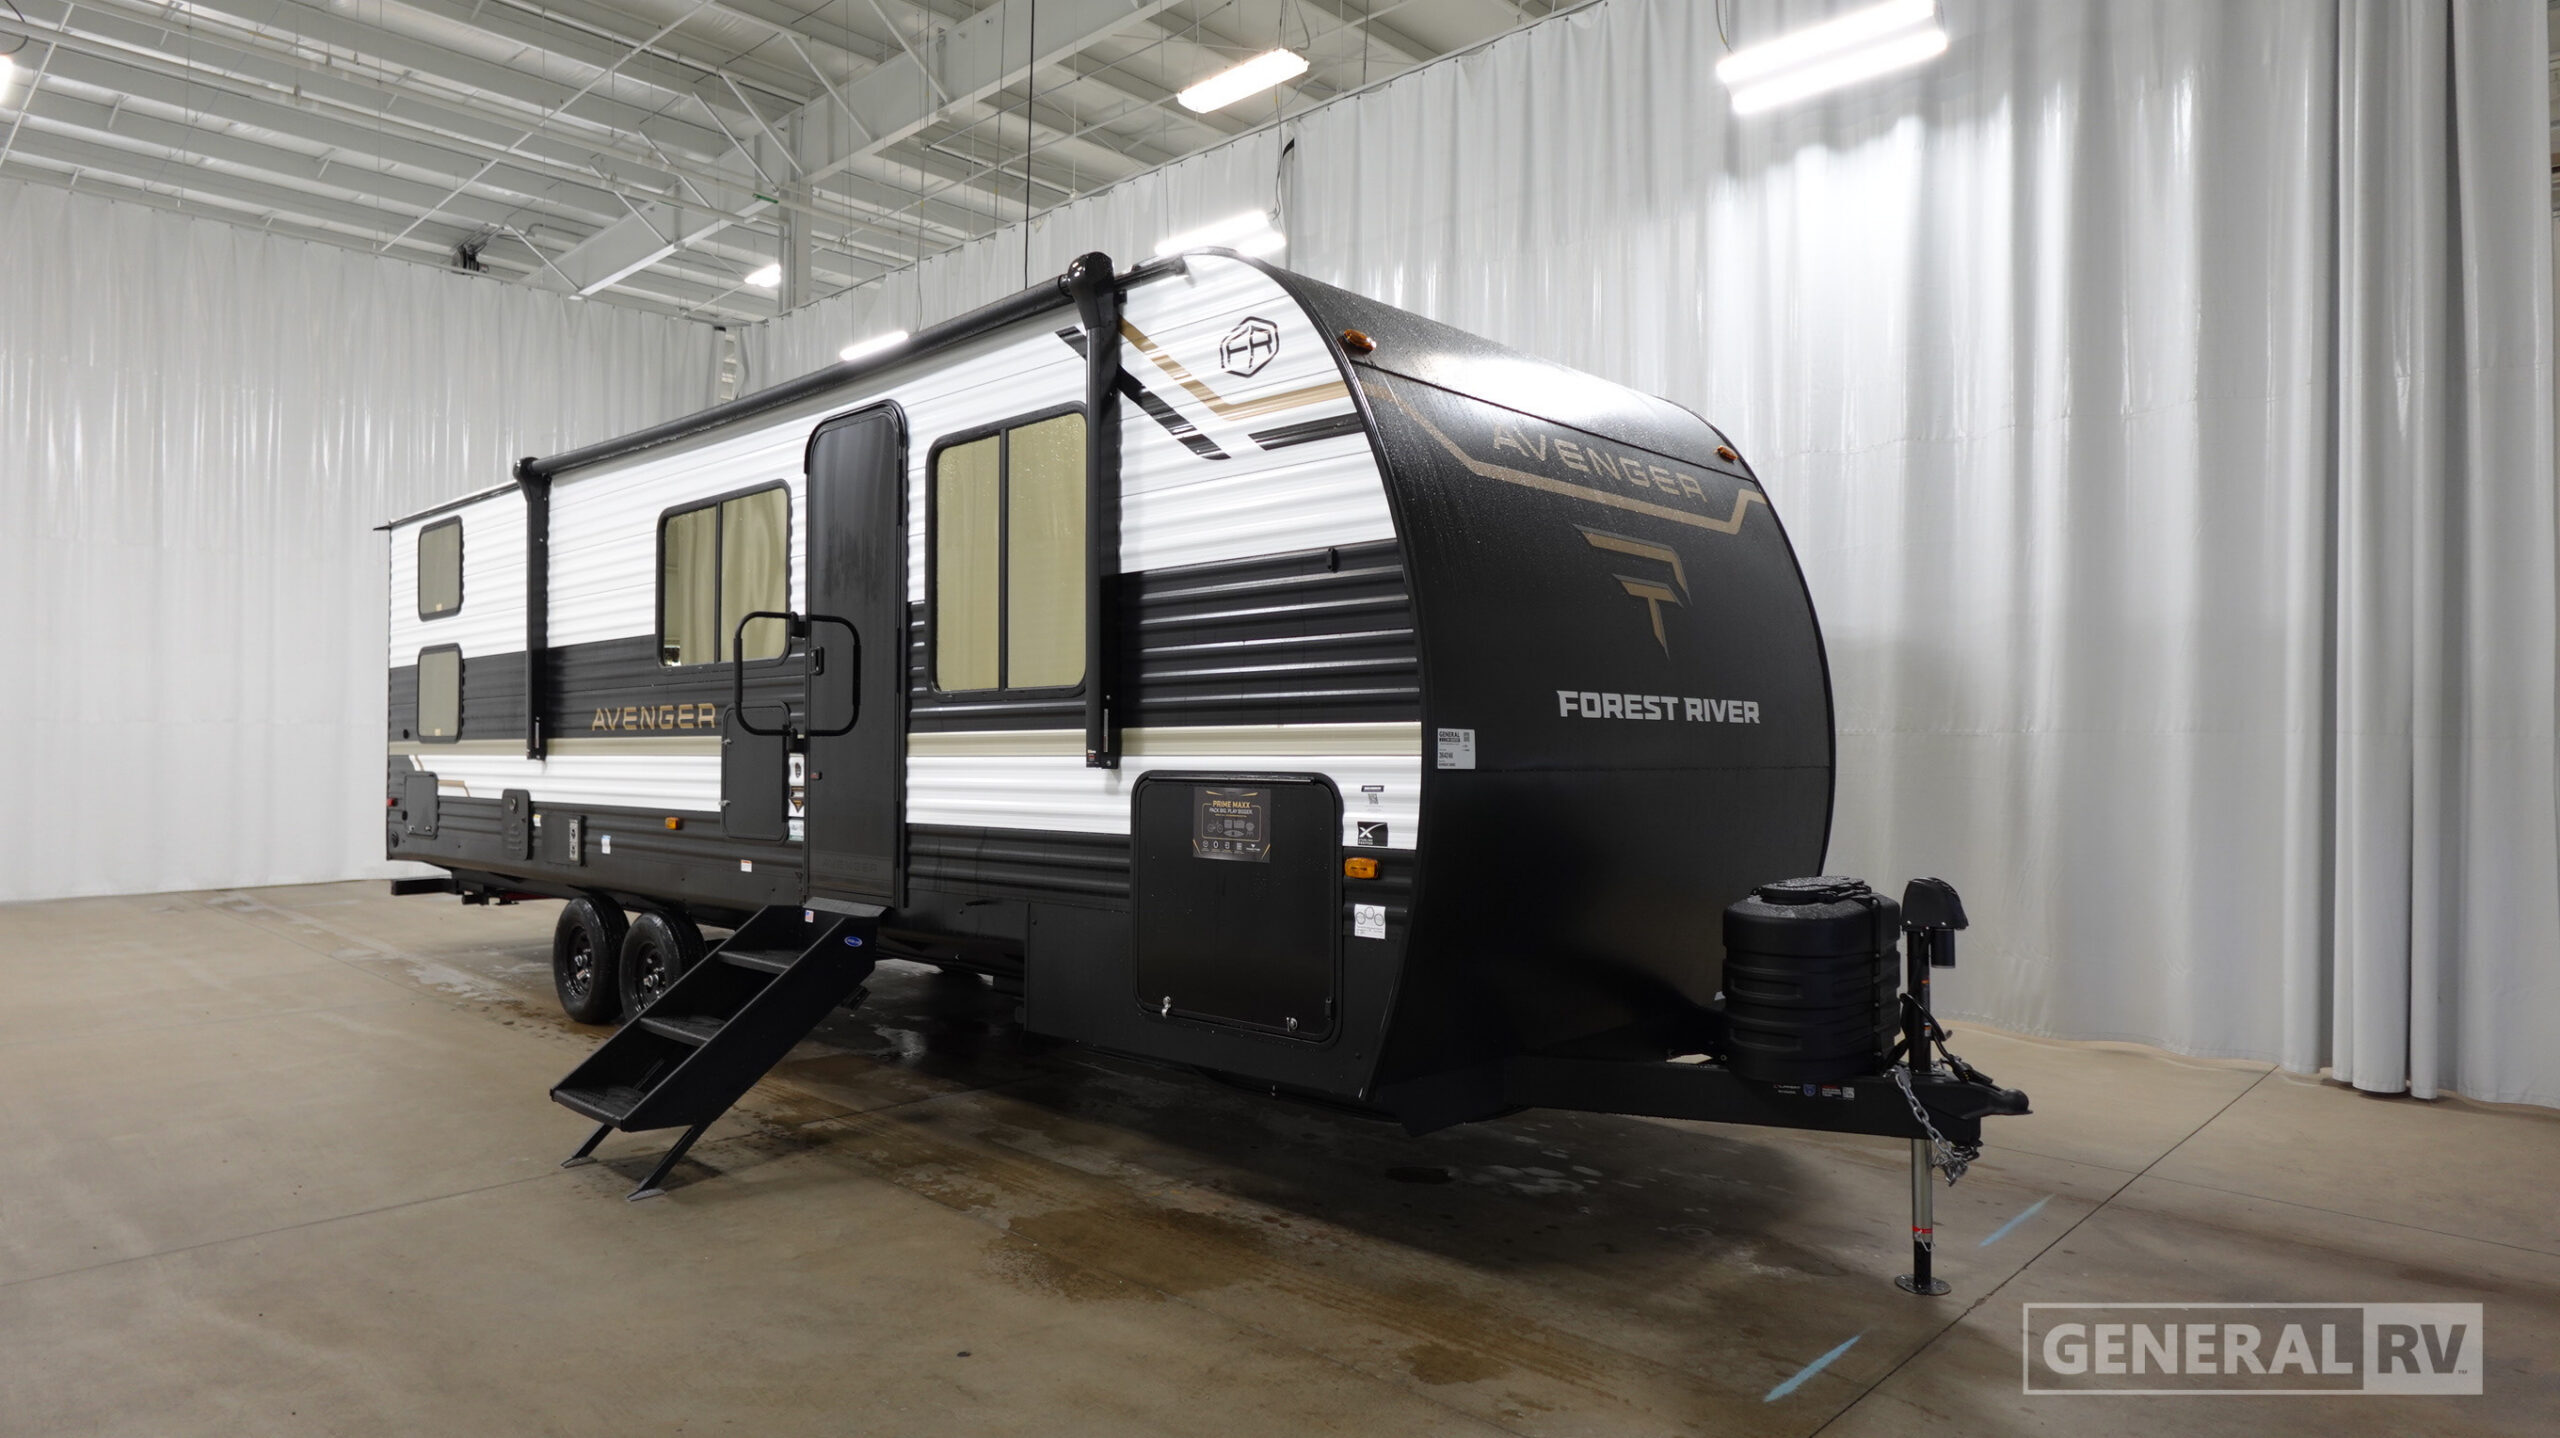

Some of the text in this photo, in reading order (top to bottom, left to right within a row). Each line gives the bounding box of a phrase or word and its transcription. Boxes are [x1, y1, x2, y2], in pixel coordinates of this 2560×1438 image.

[1492, 424, 1708, 503] AVENGER
[591, 703, 717, 731] AVENGER
[1557, 690, 1761, 725] FOREST RIVER
[1212, 800, 1251, 809] PRIME MAXX
